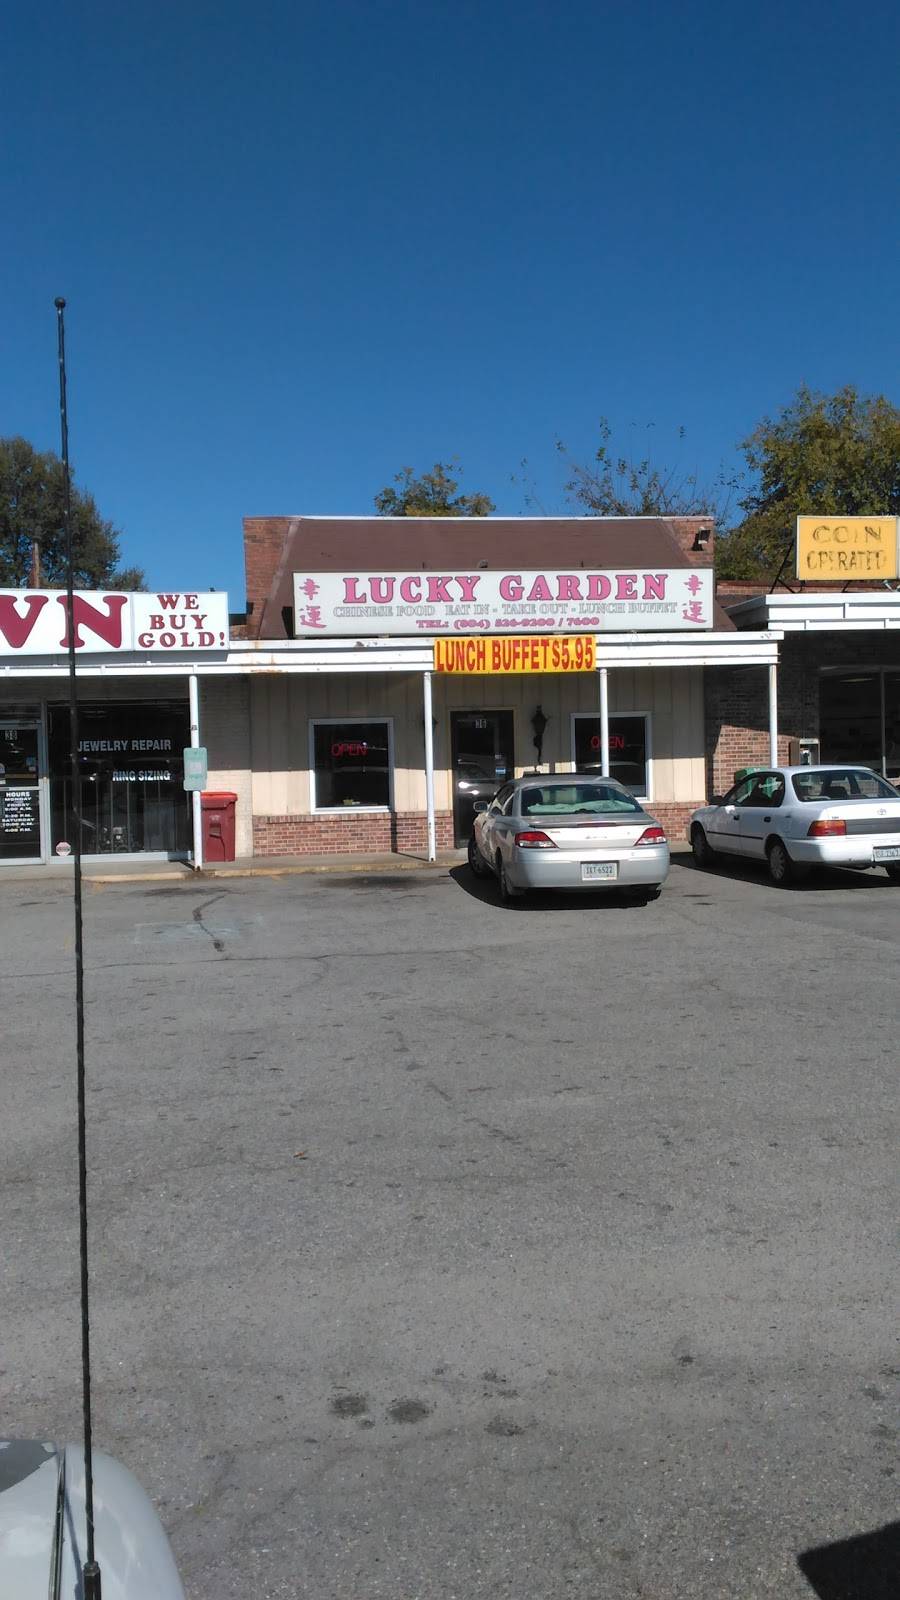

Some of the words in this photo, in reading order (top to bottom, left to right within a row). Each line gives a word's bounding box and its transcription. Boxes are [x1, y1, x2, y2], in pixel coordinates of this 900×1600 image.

[813, 525, 881, 543] COIN
[342, 576, 481, 604] LUCKY
[500, 574, 668, 601] GARDEN
[157, 594, 199, 610] WE
[333, 606, 393, 617] CHINESE
[396, 605, 435, 616] FOOD
[445, 605, 470, 616] EAT
[474, 604, 490, 615] IN
[502, 603, 536, 614] TAKE
[539, 603, 568, 614] OUT
[579, 602, 625, 614] LUNCH
[628, 602, 677, 613] BUFFET
[149, 614, 208, 630] BUY
[416, 619, 449, 628] TEL:
[138, 632, 225, 648] GOLD!
[436, 640, 486, 672] LUNCH
[78, 740, 128, 751] JEWELRY
[132, 739, 171, 750] REPAIR
[591, 735, 625, 749] OEN
[331, 743, 368, 757] OPEN
[112, 771, 136, 781] RING
[138, 769, 171, 781] SIZING
